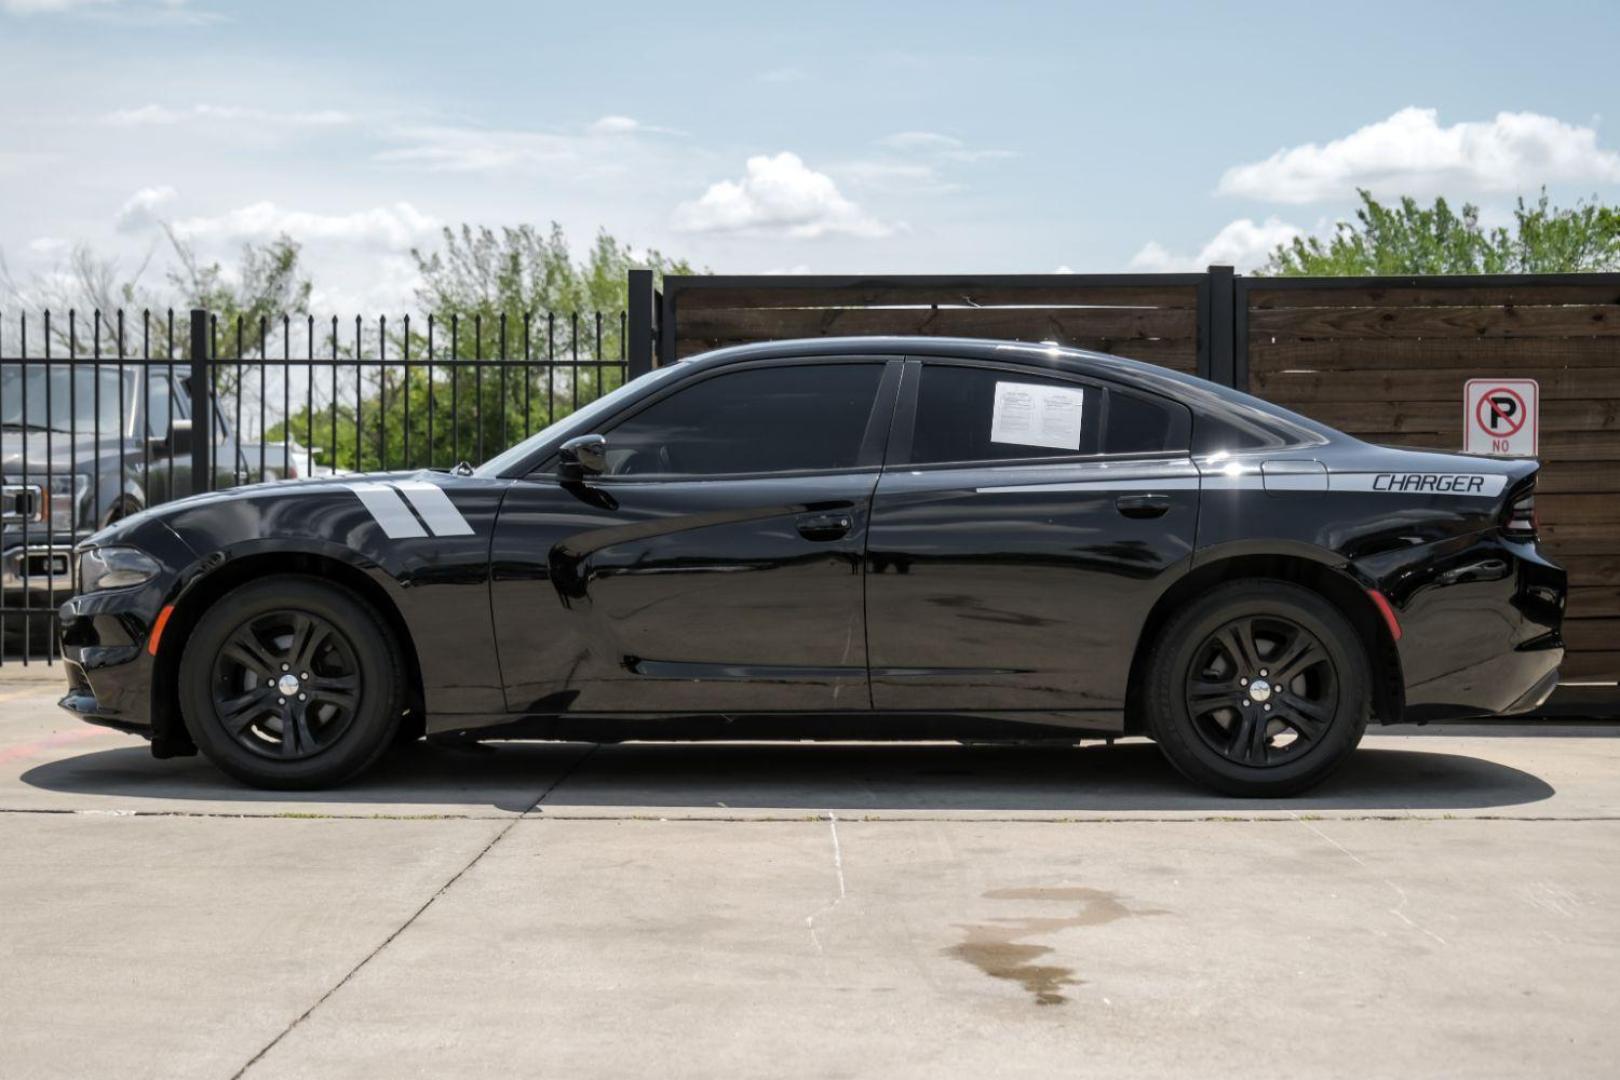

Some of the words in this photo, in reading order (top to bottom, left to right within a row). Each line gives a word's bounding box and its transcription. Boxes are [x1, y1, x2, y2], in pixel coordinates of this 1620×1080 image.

[1491, 397, 1517, 428] P
[1492, 439, 1509, 452] NO
[1372, 474, 1485, 493] CHARGER
